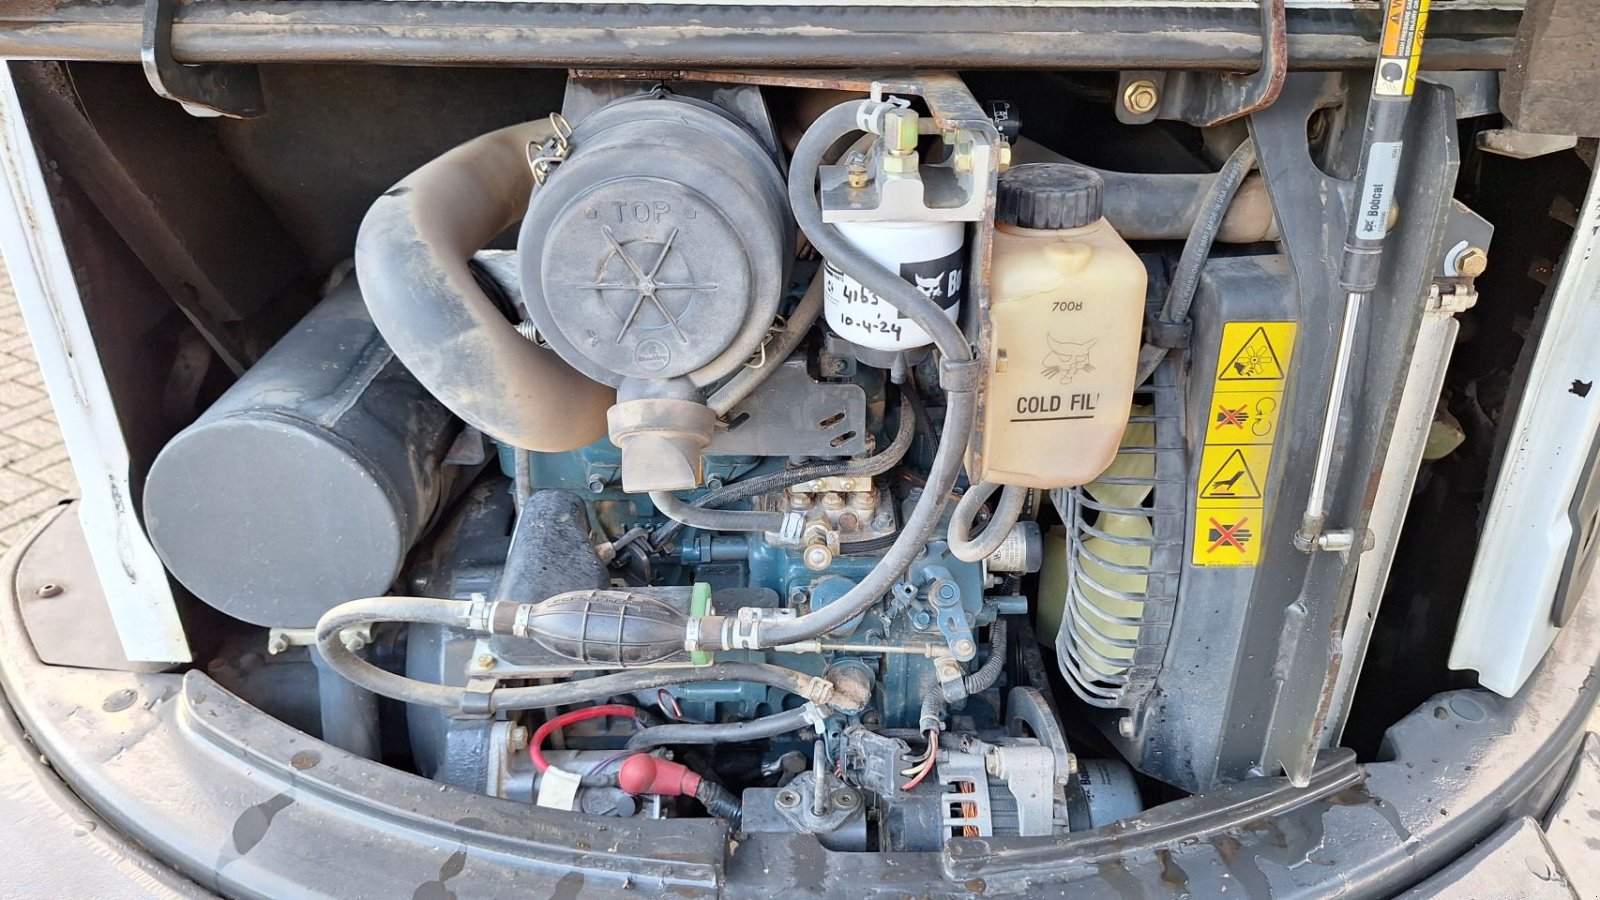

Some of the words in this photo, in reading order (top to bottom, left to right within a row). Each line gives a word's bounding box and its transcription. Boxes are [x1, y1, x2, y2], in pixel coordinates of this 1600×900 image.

[1218, 190, 1228, 204] USA
[1367, 184, 1384, 217] Bobcat
[610, 201, 671, 223] TOP
[1052, 301, 1083, 312] 7008
[841, 313, 902, 342] 10-4-24
[1016, 395, 1062, 414] COLD
